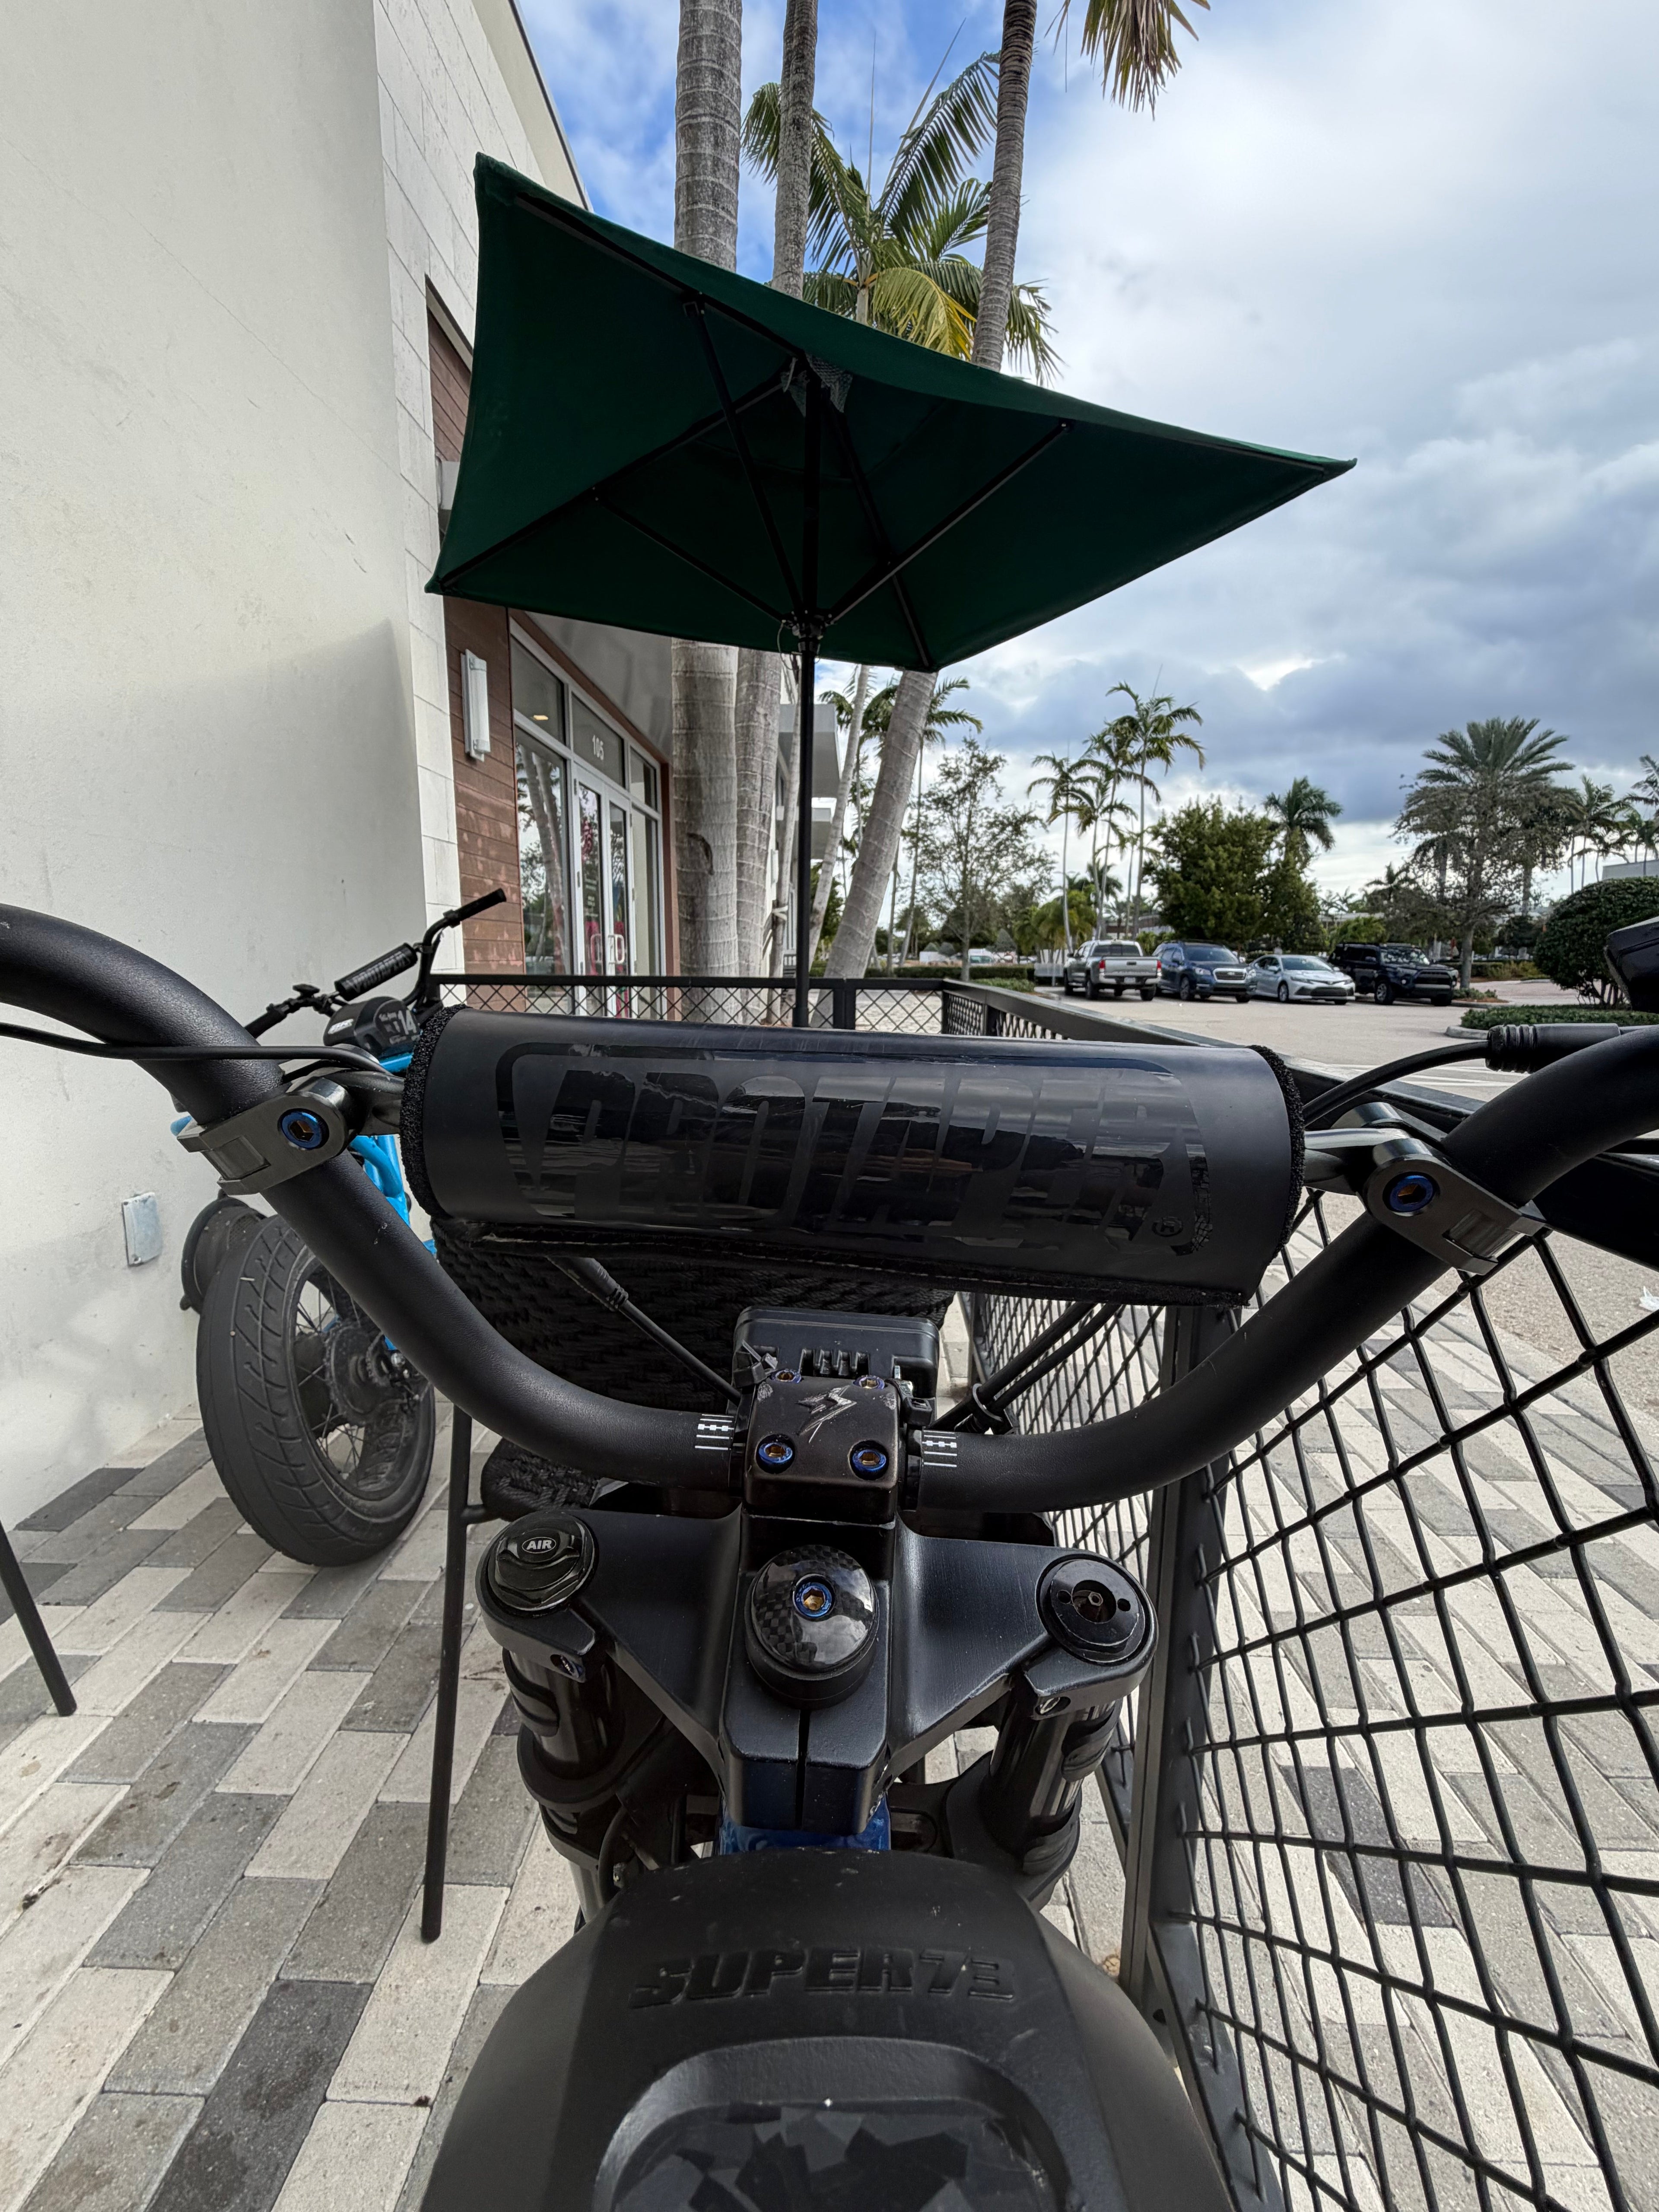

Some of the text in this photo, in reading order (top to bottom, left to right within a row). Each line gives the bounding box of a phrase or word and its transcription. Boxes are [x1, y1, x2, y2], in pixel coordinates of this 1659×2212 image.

[592, 735, 604, 760] 105
[531, 1067, 1196, 1250] PROTAPER
[526, 1540, 552, 1550] AIR
[628, 1947, 1016, 2009] SUPER73
